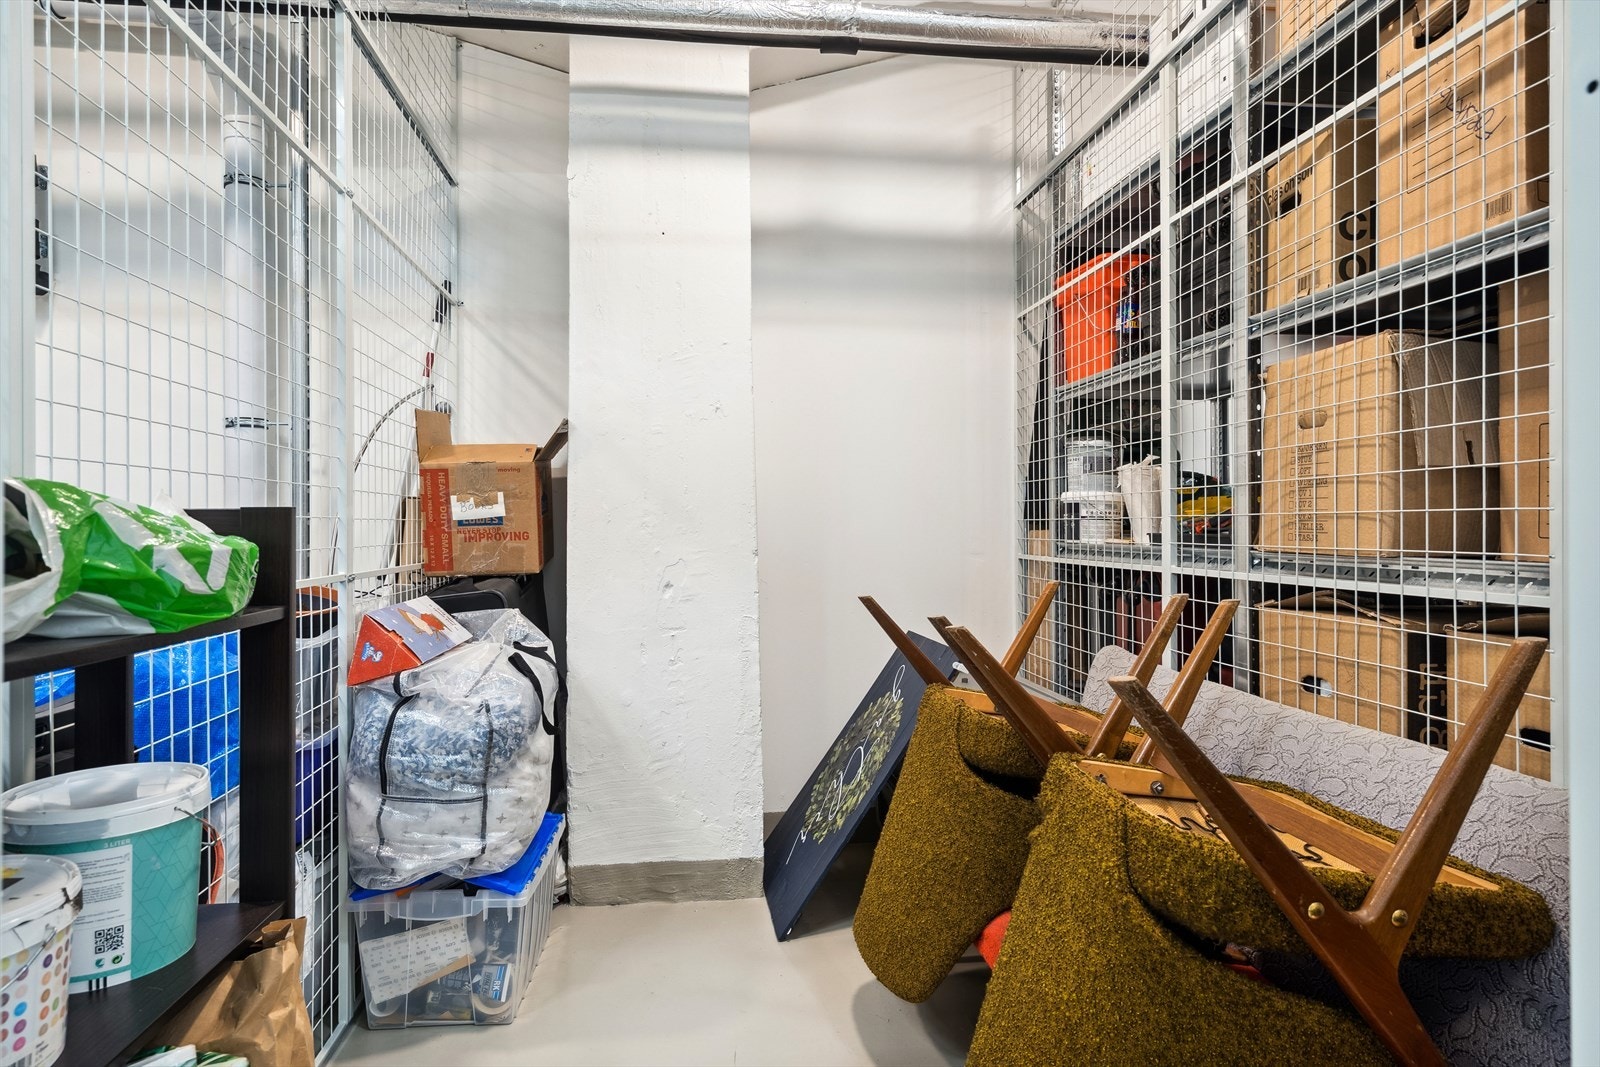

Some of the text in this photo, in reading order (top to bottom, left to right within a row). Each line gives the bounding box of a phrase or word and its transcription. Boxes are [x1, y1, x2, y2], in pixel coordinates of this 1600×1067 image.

[1284, 166, 1313, 193] ohson
[438, 472, 450, 565] HEAVY DUTY SMALL
[456, 526, 502, 535] NEVER STOP
[464, 531, 530, 543] IMPROVING
[110, 838, 131, 848] LITER
